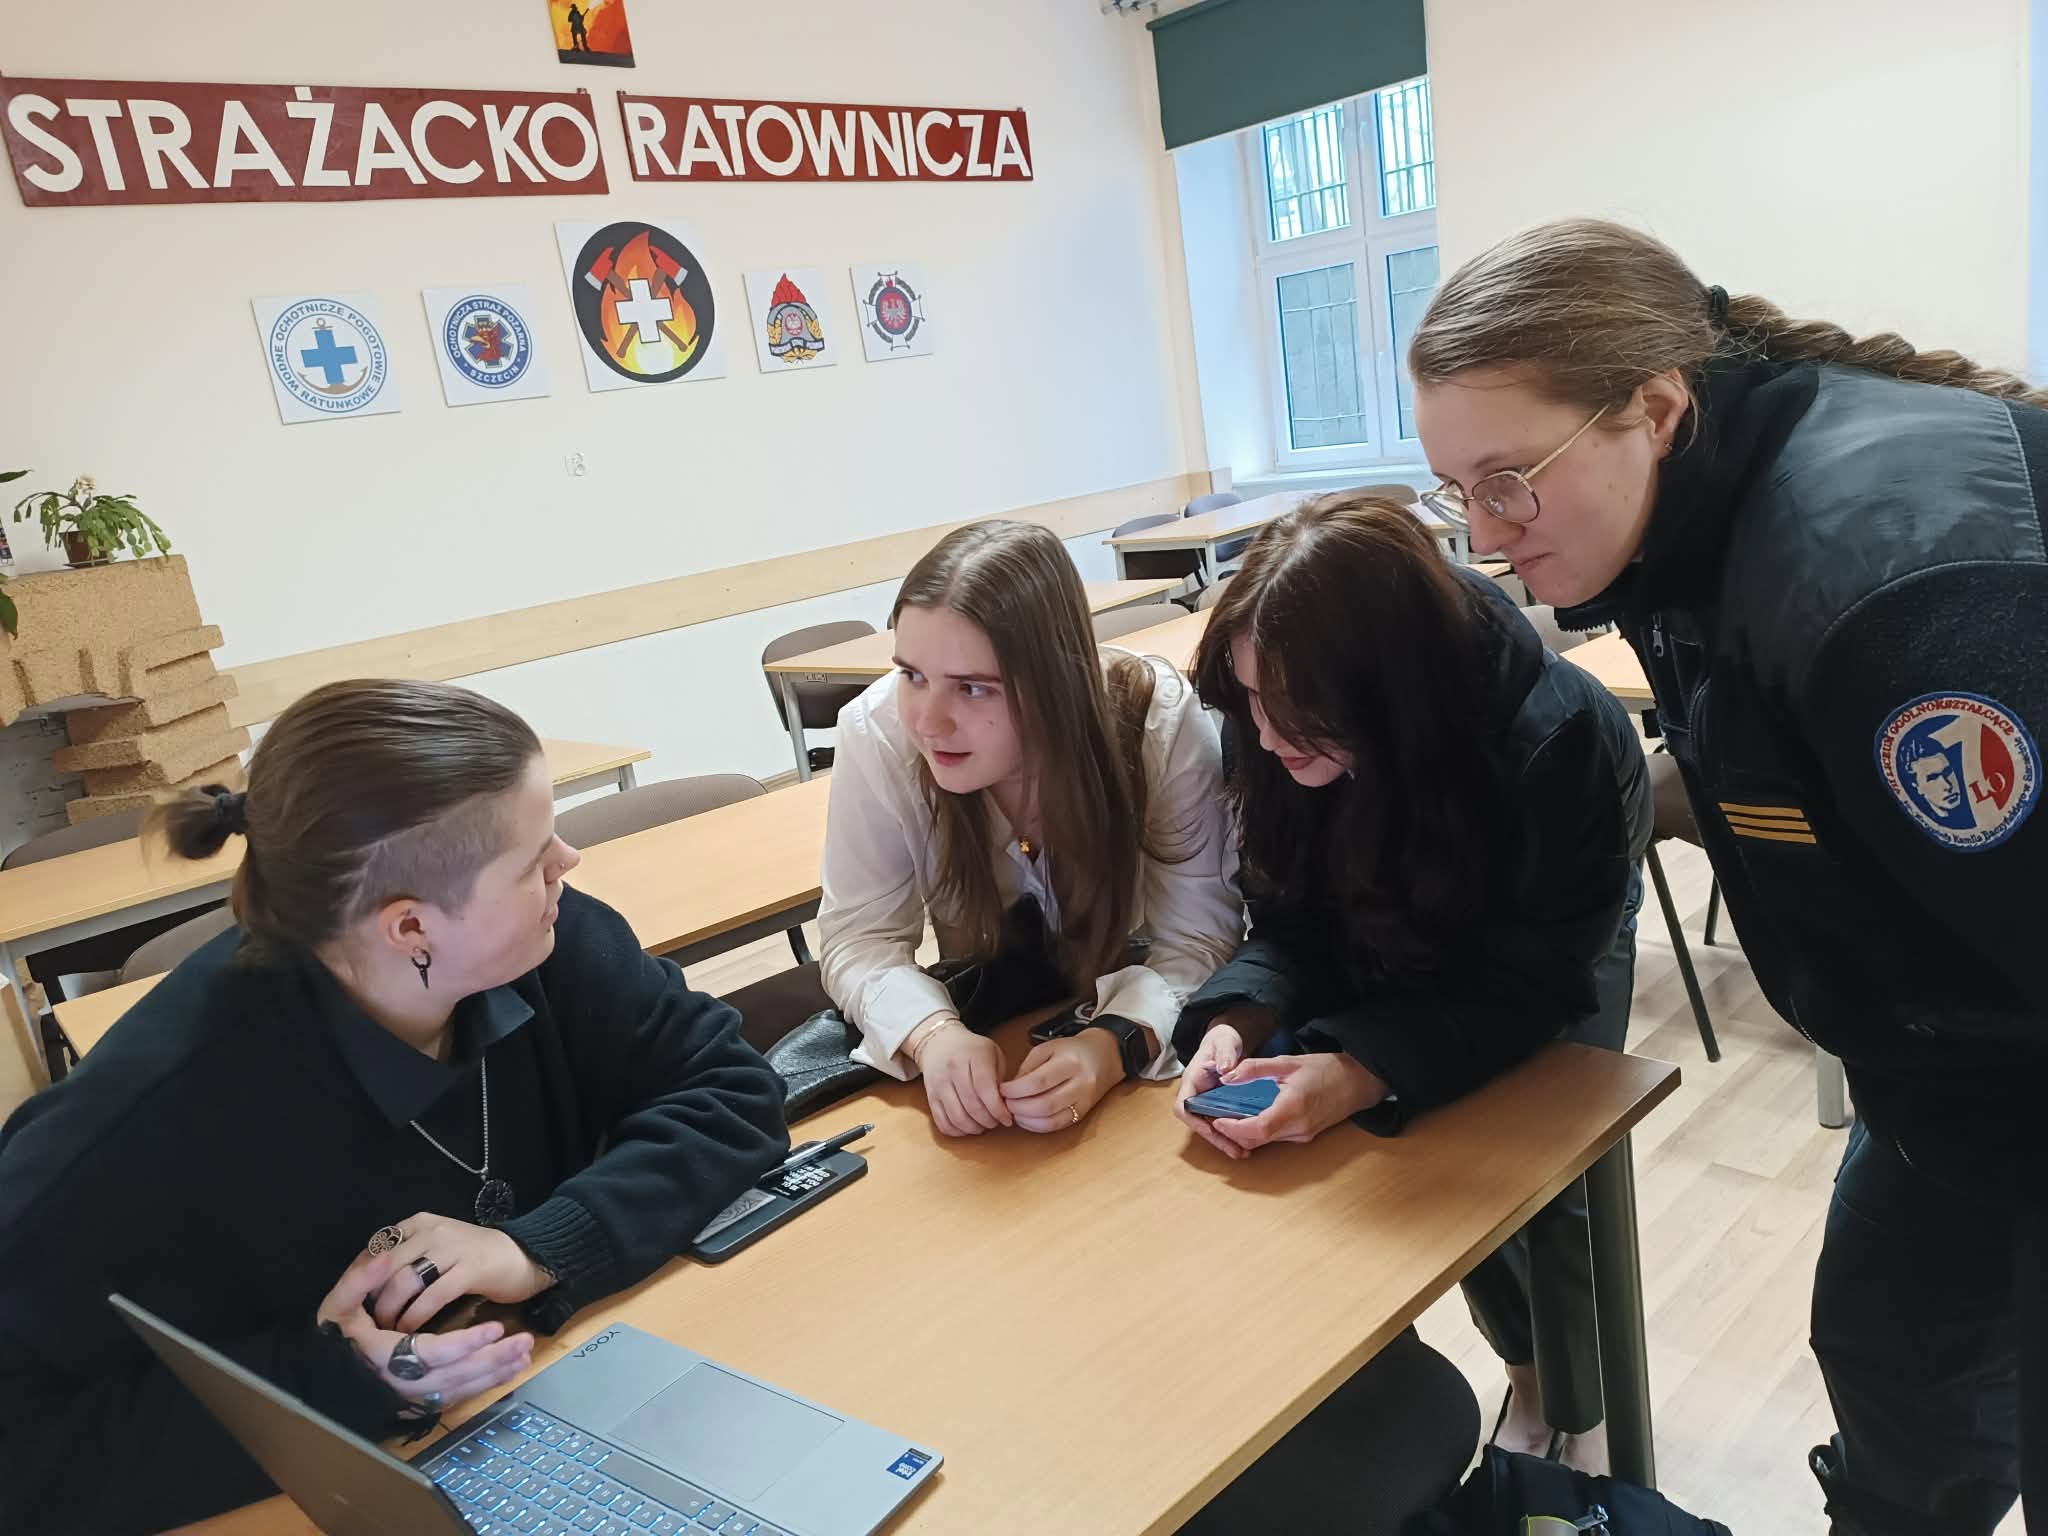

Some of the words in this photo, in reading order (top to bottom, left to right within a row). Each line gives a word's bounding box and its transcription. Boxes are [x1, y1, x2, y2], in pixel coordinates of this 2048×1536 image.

[7, 86, 599, 193] STRAŻACKO
[623, 102, 1032, 177] RATOWNICZA
[275, 303, 345, 342] OCHOTNICZE
[347, 312, 383, 383] POGOTOWIE
[274, 345, 299, 391] WODNE
[469, 366, 520, 383] SZCZECIN
[300, 384, 376, 409] RATUNKOWE
[571, 1331, 622, 1358] YOGA
